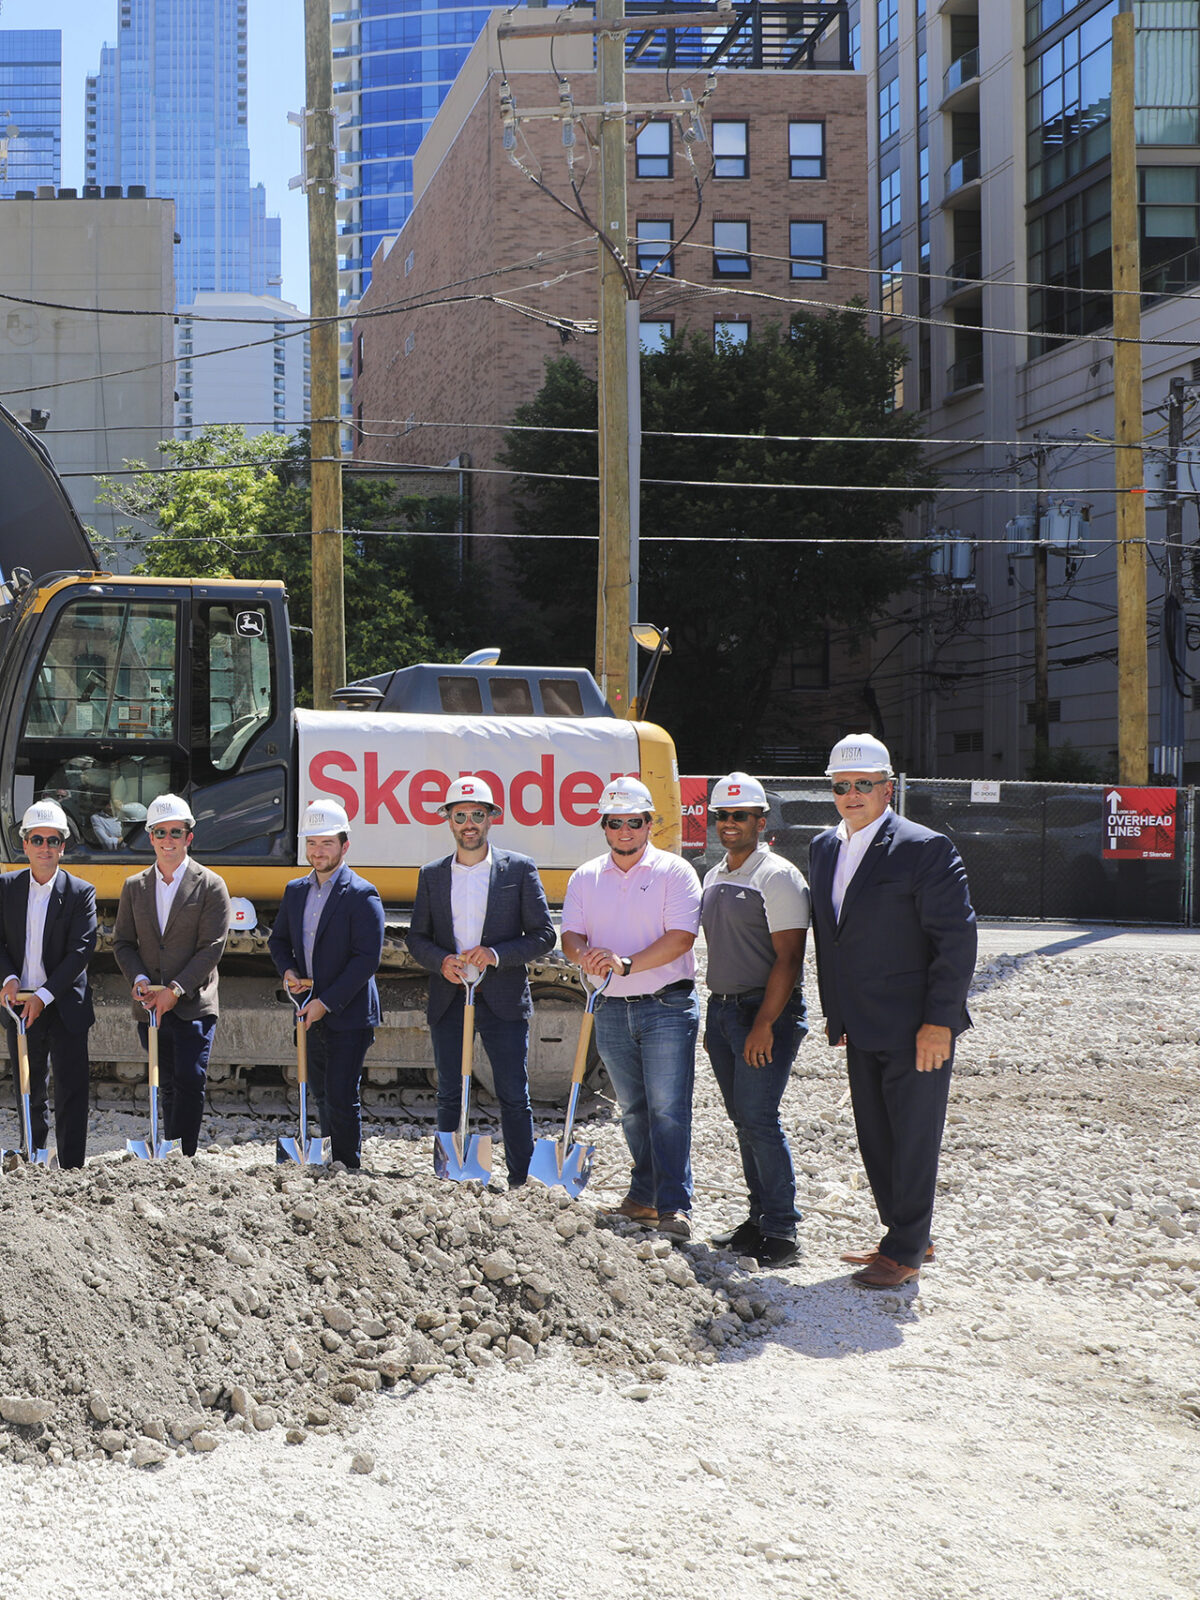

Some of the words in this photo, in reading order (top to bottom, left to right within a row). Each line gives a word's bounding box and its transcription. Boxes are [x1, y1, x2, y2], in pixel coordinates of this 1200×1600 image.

[841, 747, 863, 758] VISTA
[308, 750, 640, 826] Skende
[1107, 815, 1173, 826] OVERHEAD
[1107, 826, 1142, 837] LINES
